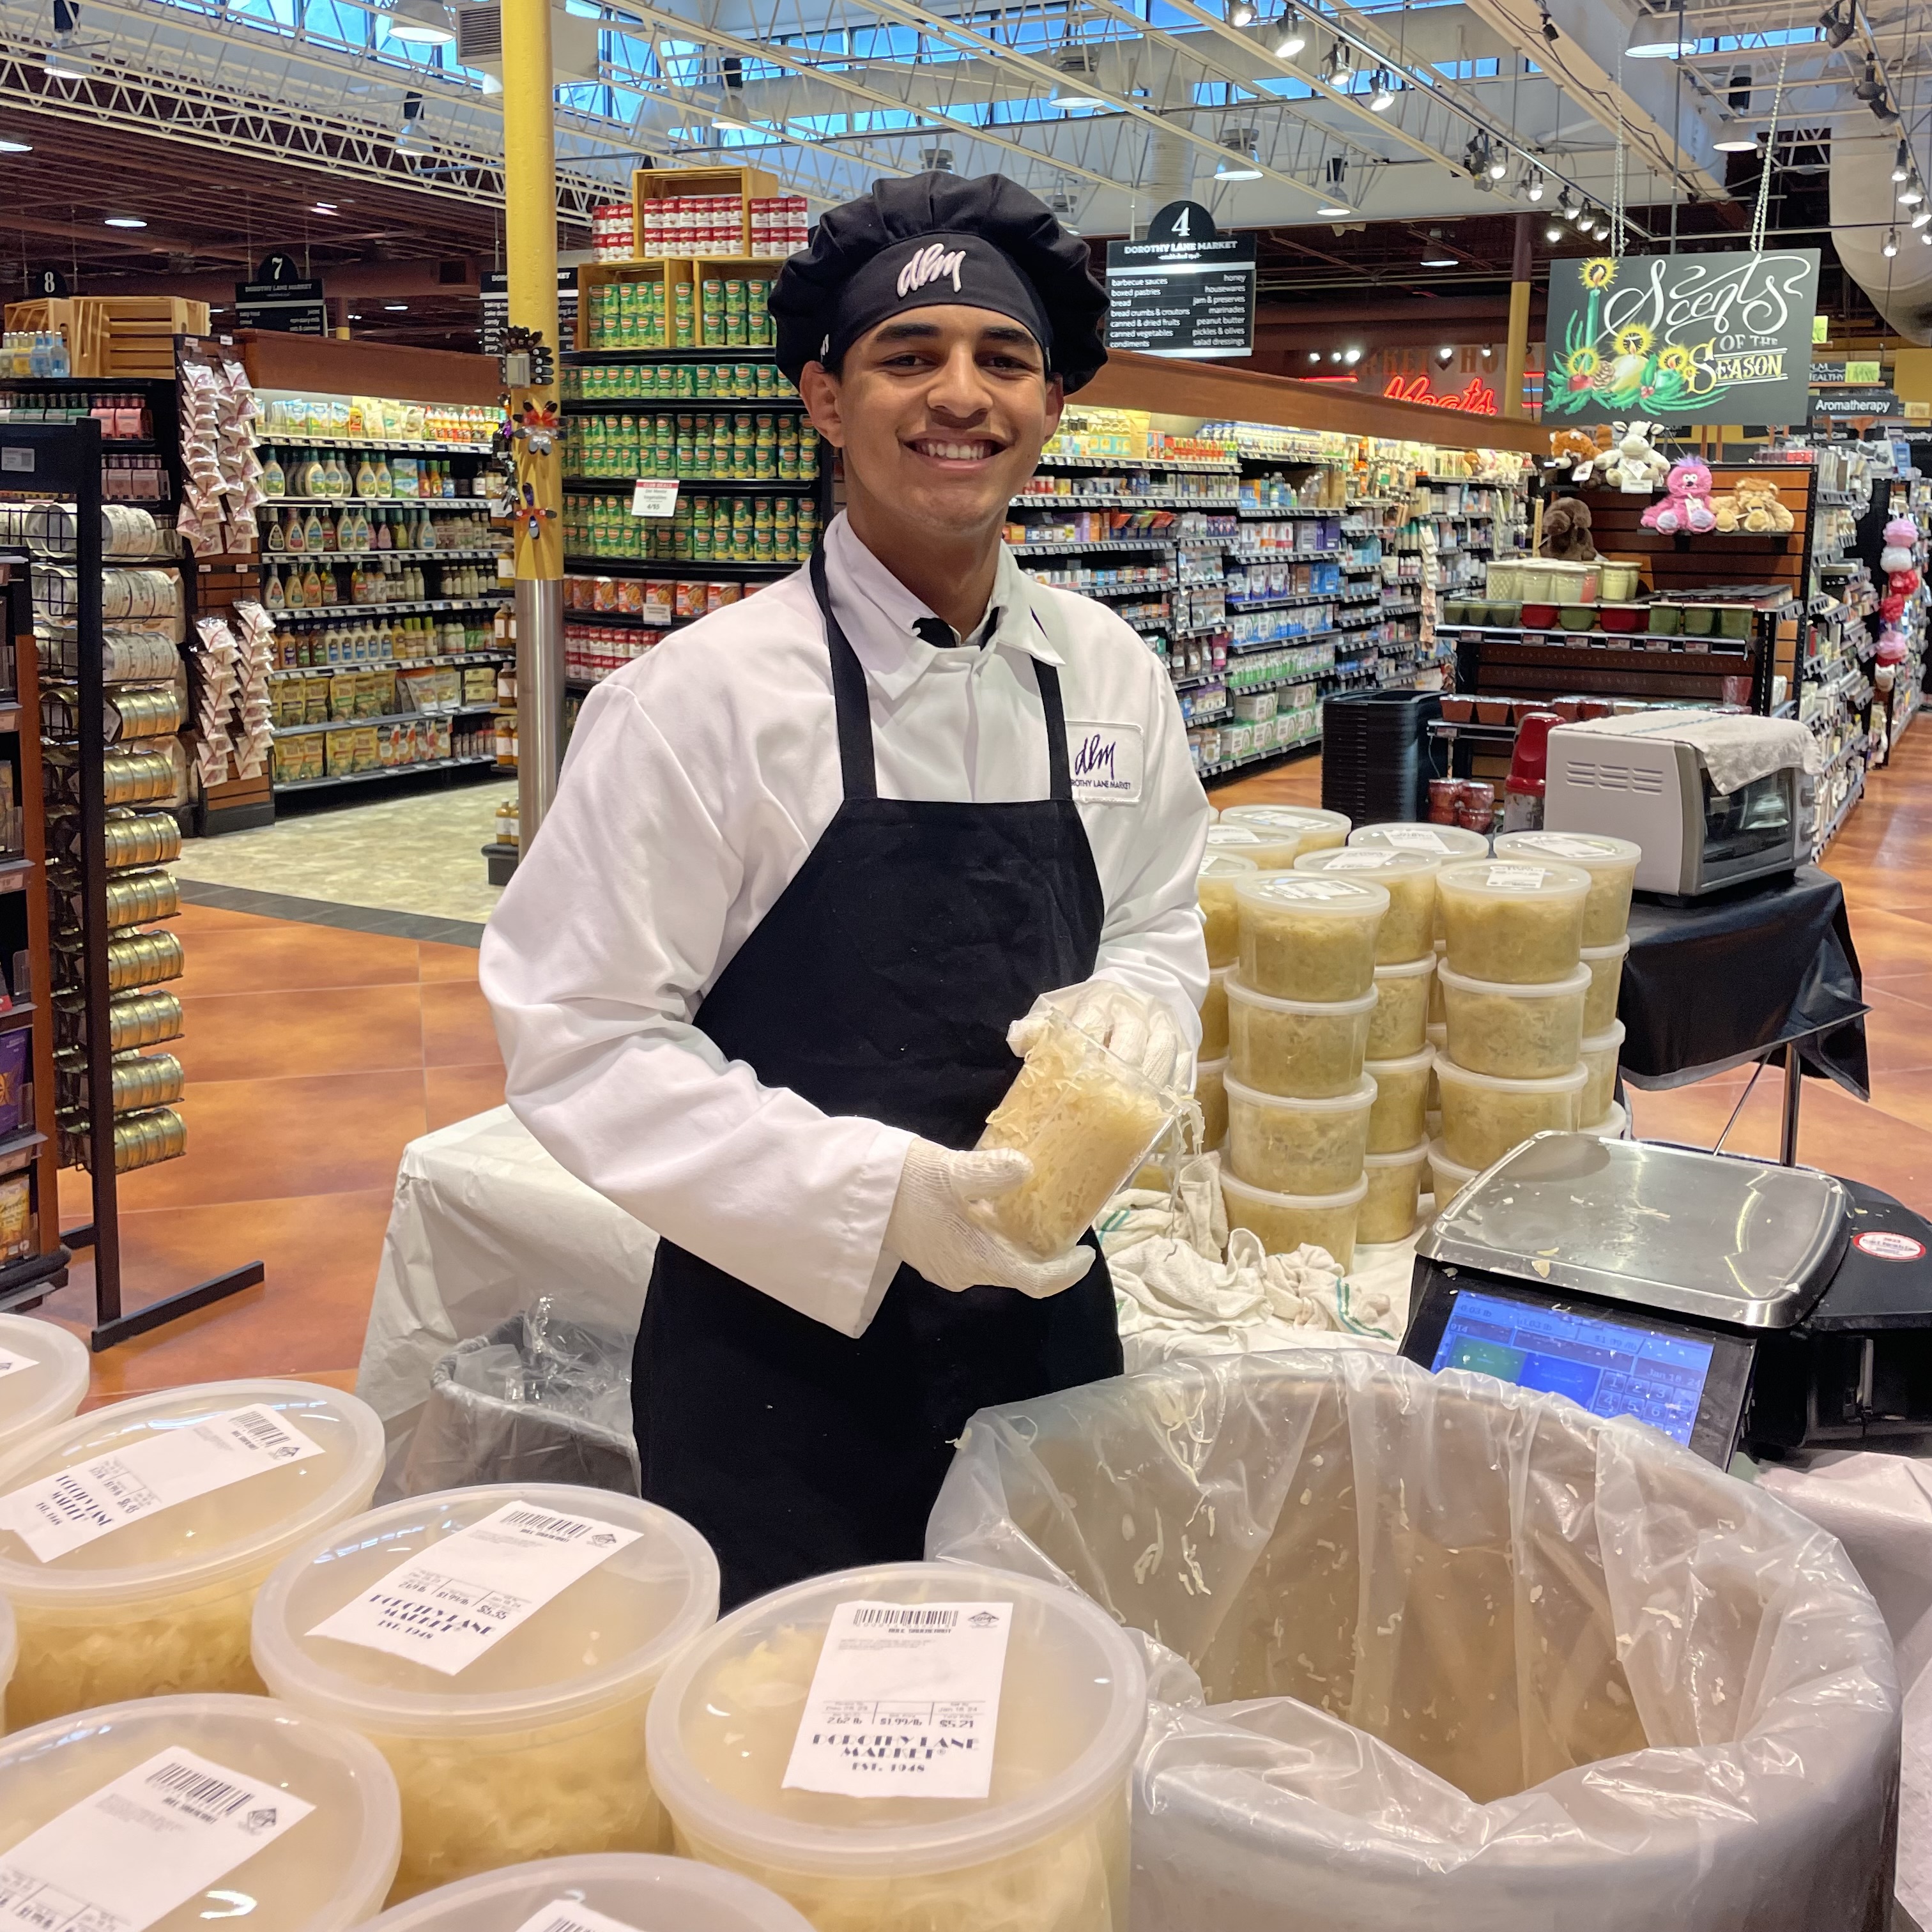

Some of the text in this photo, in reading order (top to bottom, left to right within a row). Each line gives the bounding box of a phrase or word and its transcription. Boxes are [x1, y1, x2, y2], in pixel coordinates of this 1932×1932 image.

[1171, 207, 1190, 236] 4
[1124, 241, 1238, 254] DOROTHY LANE MARKET
[272, 257, 282, 280] 7
[44, 272, 55, 293] 8
[1134, 289, 1162, 298] pastries
[1593, 253, 1811, 347] Scents
[1110, 299, 1132, 307] bread
[1213, 296, 1246, 305] preserves
[1110, 308, 1191, 318] bread crumbs & croutons
[1110, 319, 1136, 328] canned
[1137, 319, 1142, 327] &
[1196, 318, 1222, 326] peanut
[1136, 329, 1174, 339] vegetables
[1192, 329, 1217, 337] pickles
[1217, 327, 1223, 335] &
[1109, 340, 1150, 348] condiments
[1212, 338, 1245, 347] dressings
[1720, 334, 1778, 352] OF THE
[1686, 337, 1782, 395] SEASON
[1815, 399, 1891, 413] Aromatherapy
[1075, 733, 1116, 780] dlm
[1483, 1309, 1492, 1317] lb
[1450, 1323, 1468, 1333] 914
[1646, 1368, 1667, 1381] Jan
[1687, 1378, 1701, 1389] 24
[1609, 1377, 1666, 1399] 1 2 3
[1604, 1394, 1614, 1406] 4
[1651, 1406, 1660, 1417] 6
[813, 1734, 980, 1750] DOROTHY LANE
